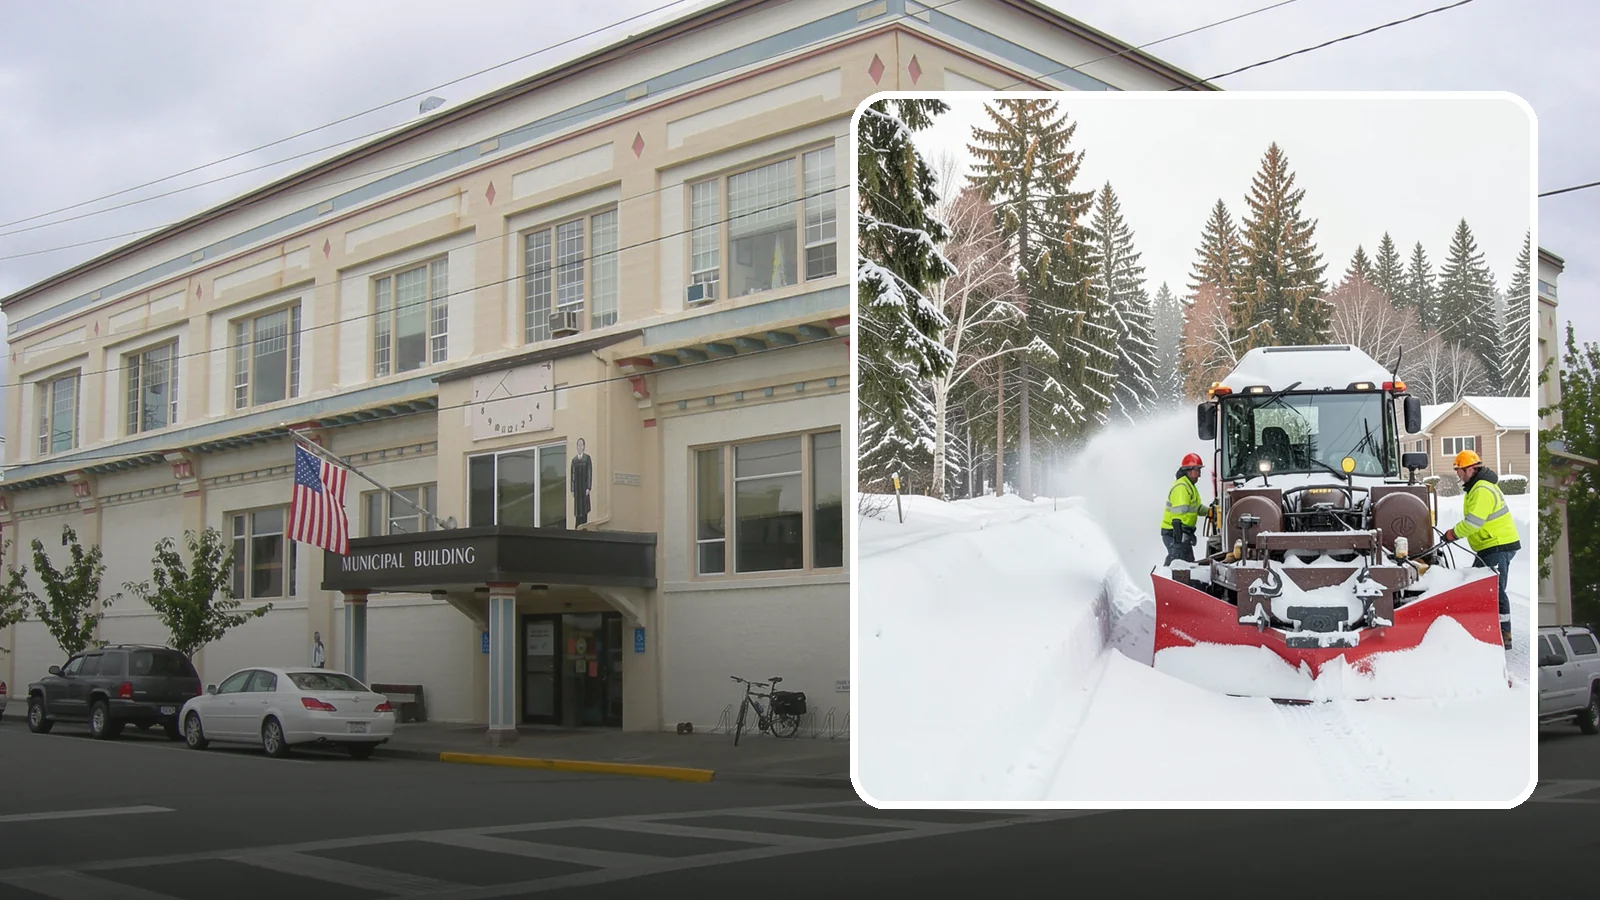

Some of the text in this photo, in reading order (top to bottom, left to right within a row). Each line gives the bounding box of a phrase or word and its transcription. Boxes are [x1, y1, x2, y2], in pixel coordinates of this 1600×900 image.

[475, 390, 479, 398] 7
[536, 402, 540, 410] 4
[481, 407, 485, 415] 8
[488, 417, 492, 426] 9
[529, 414, 533, 422] 3
[494, 424, 500, 432] 10
[521, 420, 525, 428] 2
[507, 425, 513, 433] 12
[342, 546, 475, 572] MUNICIPAL BUILDING
